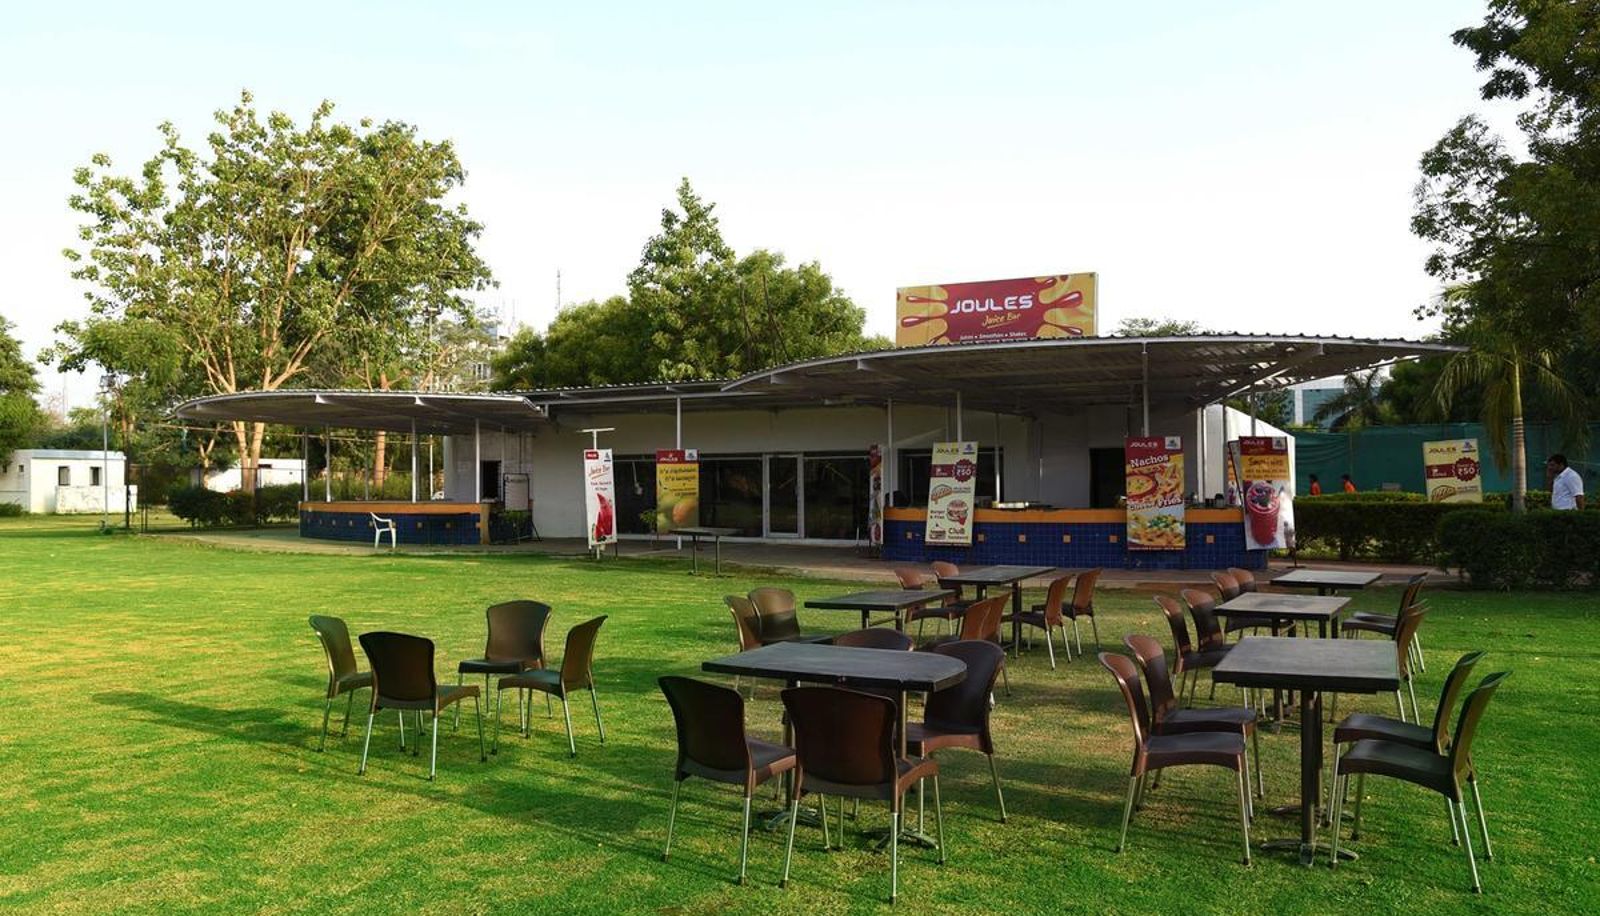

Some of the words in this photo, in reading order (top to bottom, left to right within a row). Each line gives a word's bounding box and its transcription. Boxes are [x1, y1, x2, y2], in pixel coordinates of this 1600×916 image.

[951, 295, 1033, 314] JOULES
[981, 313, 1006, 327] Juice
[1007, 312, 1021, 321] Bar
[1130, 454, 1169, 468] Nachos
